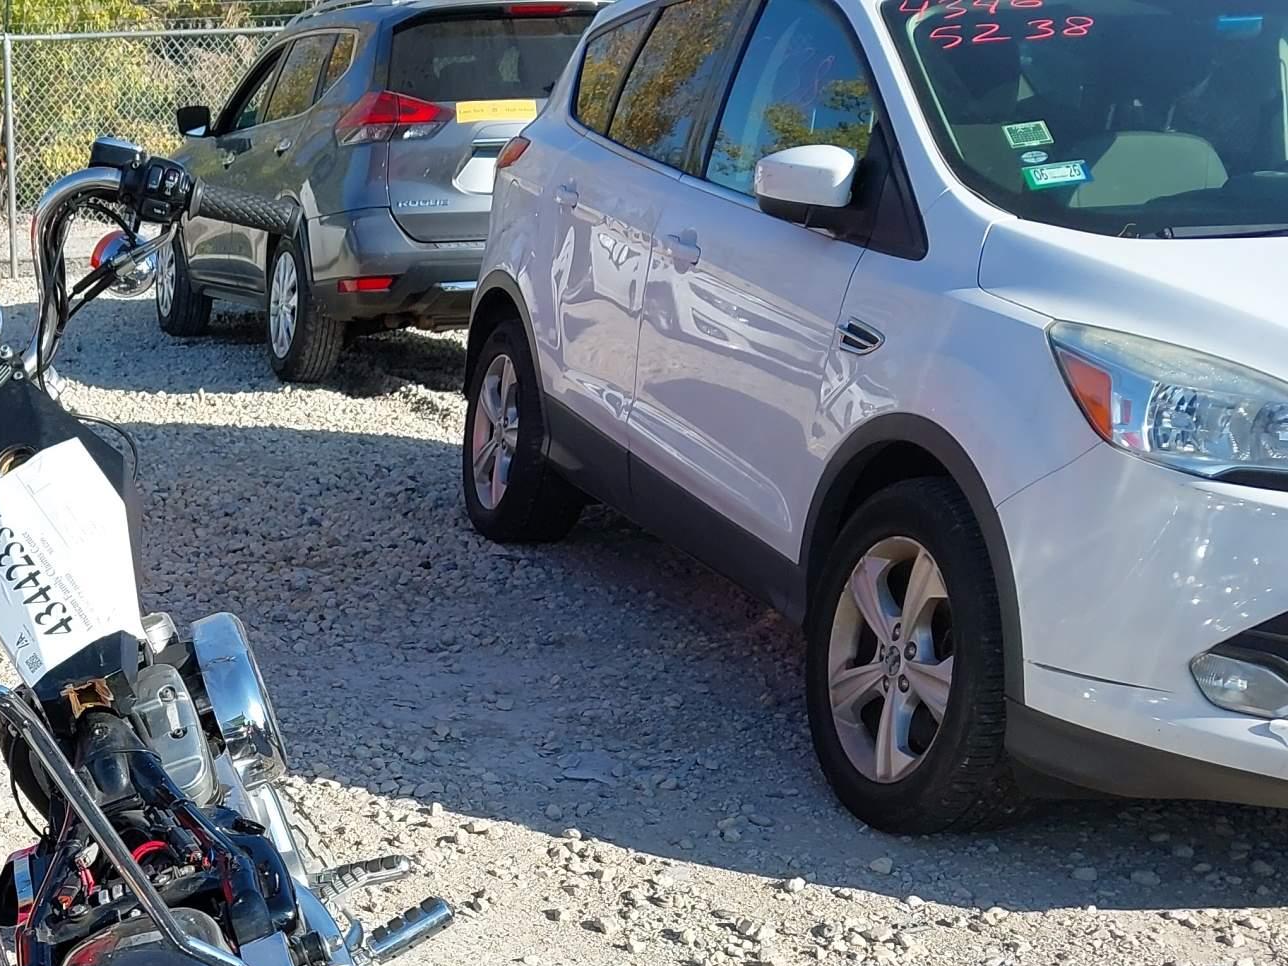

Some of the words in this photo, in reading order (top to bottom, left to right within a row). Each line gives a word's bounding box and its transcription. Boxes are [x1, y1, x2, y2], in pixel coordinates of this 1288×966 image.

[397, 199, 450, 208] ROGUE
[21, 531, 40, 554] Center
[37, 553, 57, 577] Claims
[53, 575, 75, 602] Family
